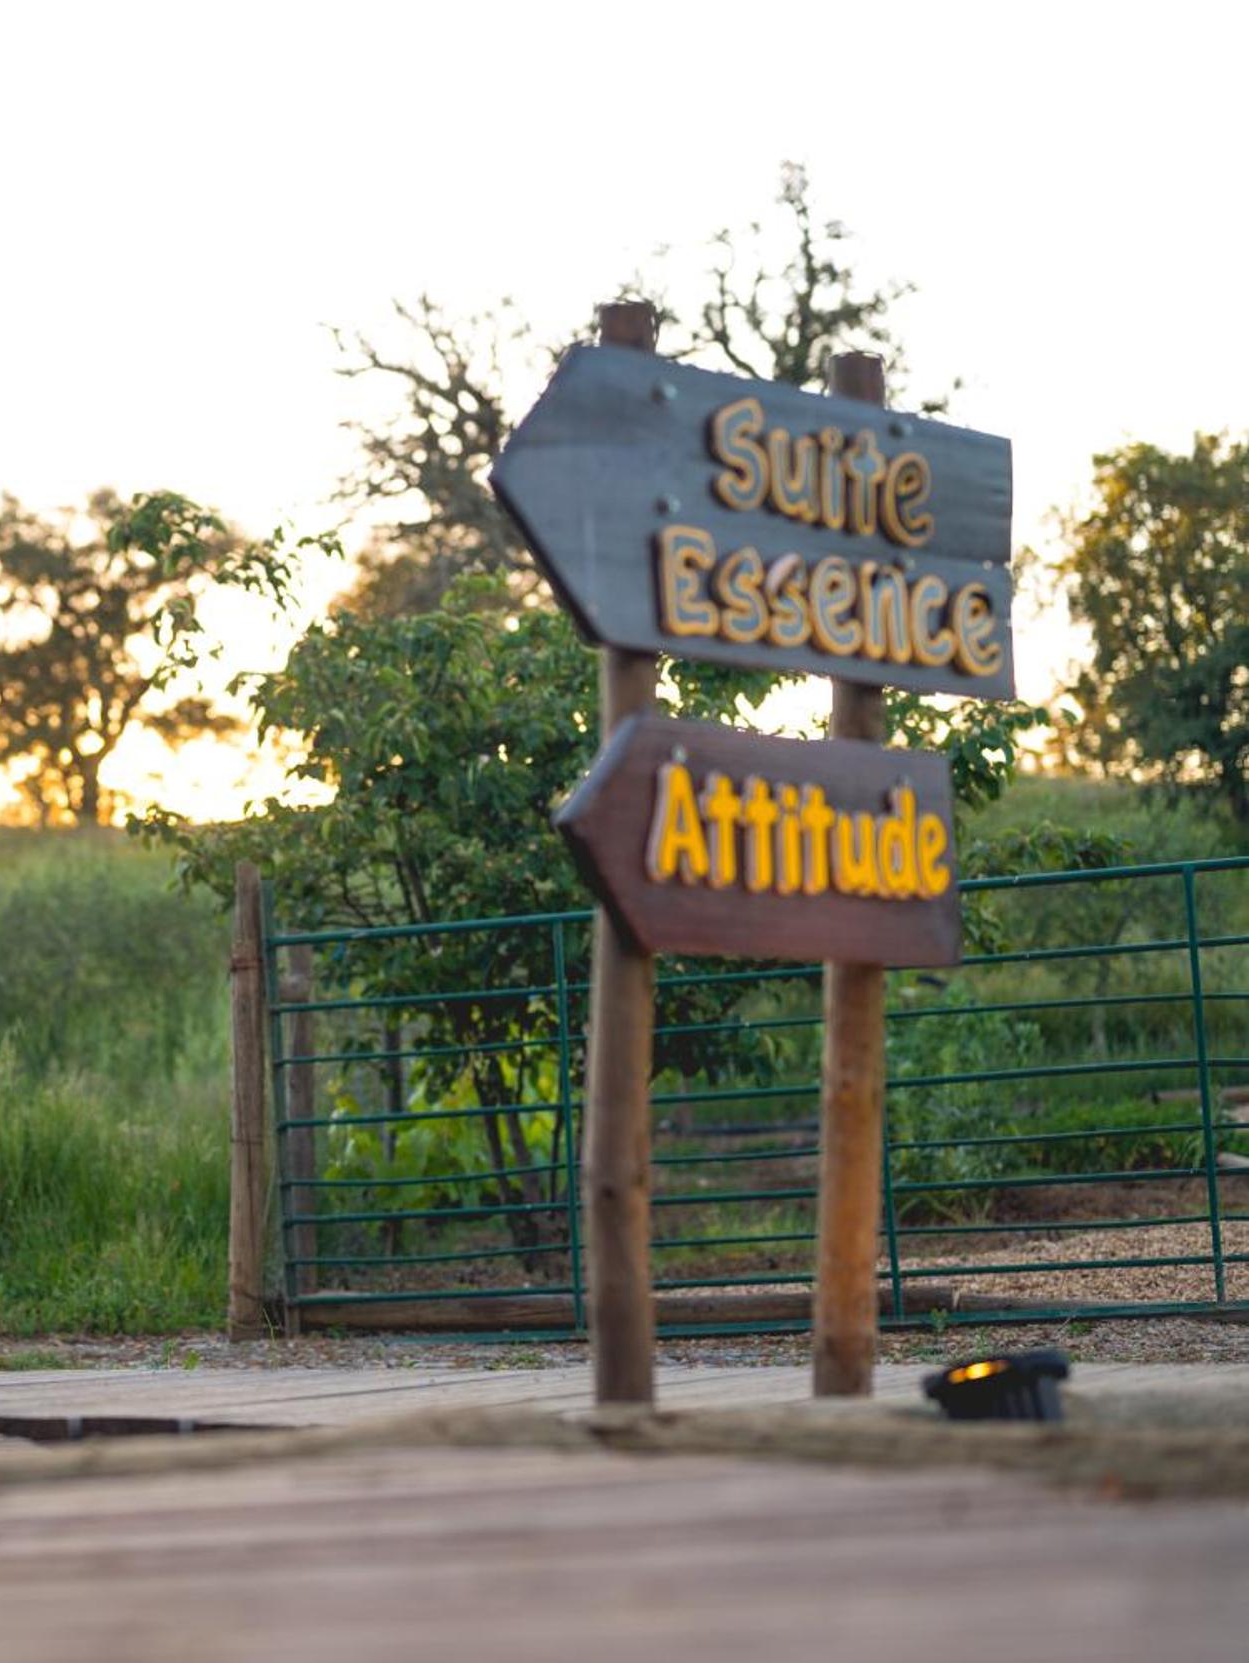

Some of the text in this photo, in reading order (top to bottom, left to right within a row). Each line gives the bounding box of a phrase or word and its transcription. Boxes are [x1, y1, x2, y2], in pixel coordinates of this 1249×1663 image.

[710, 397, 935, 547] Suite
[657, 525, 1004, 677] Essence
[648, 763, 950, 900] Attitude
